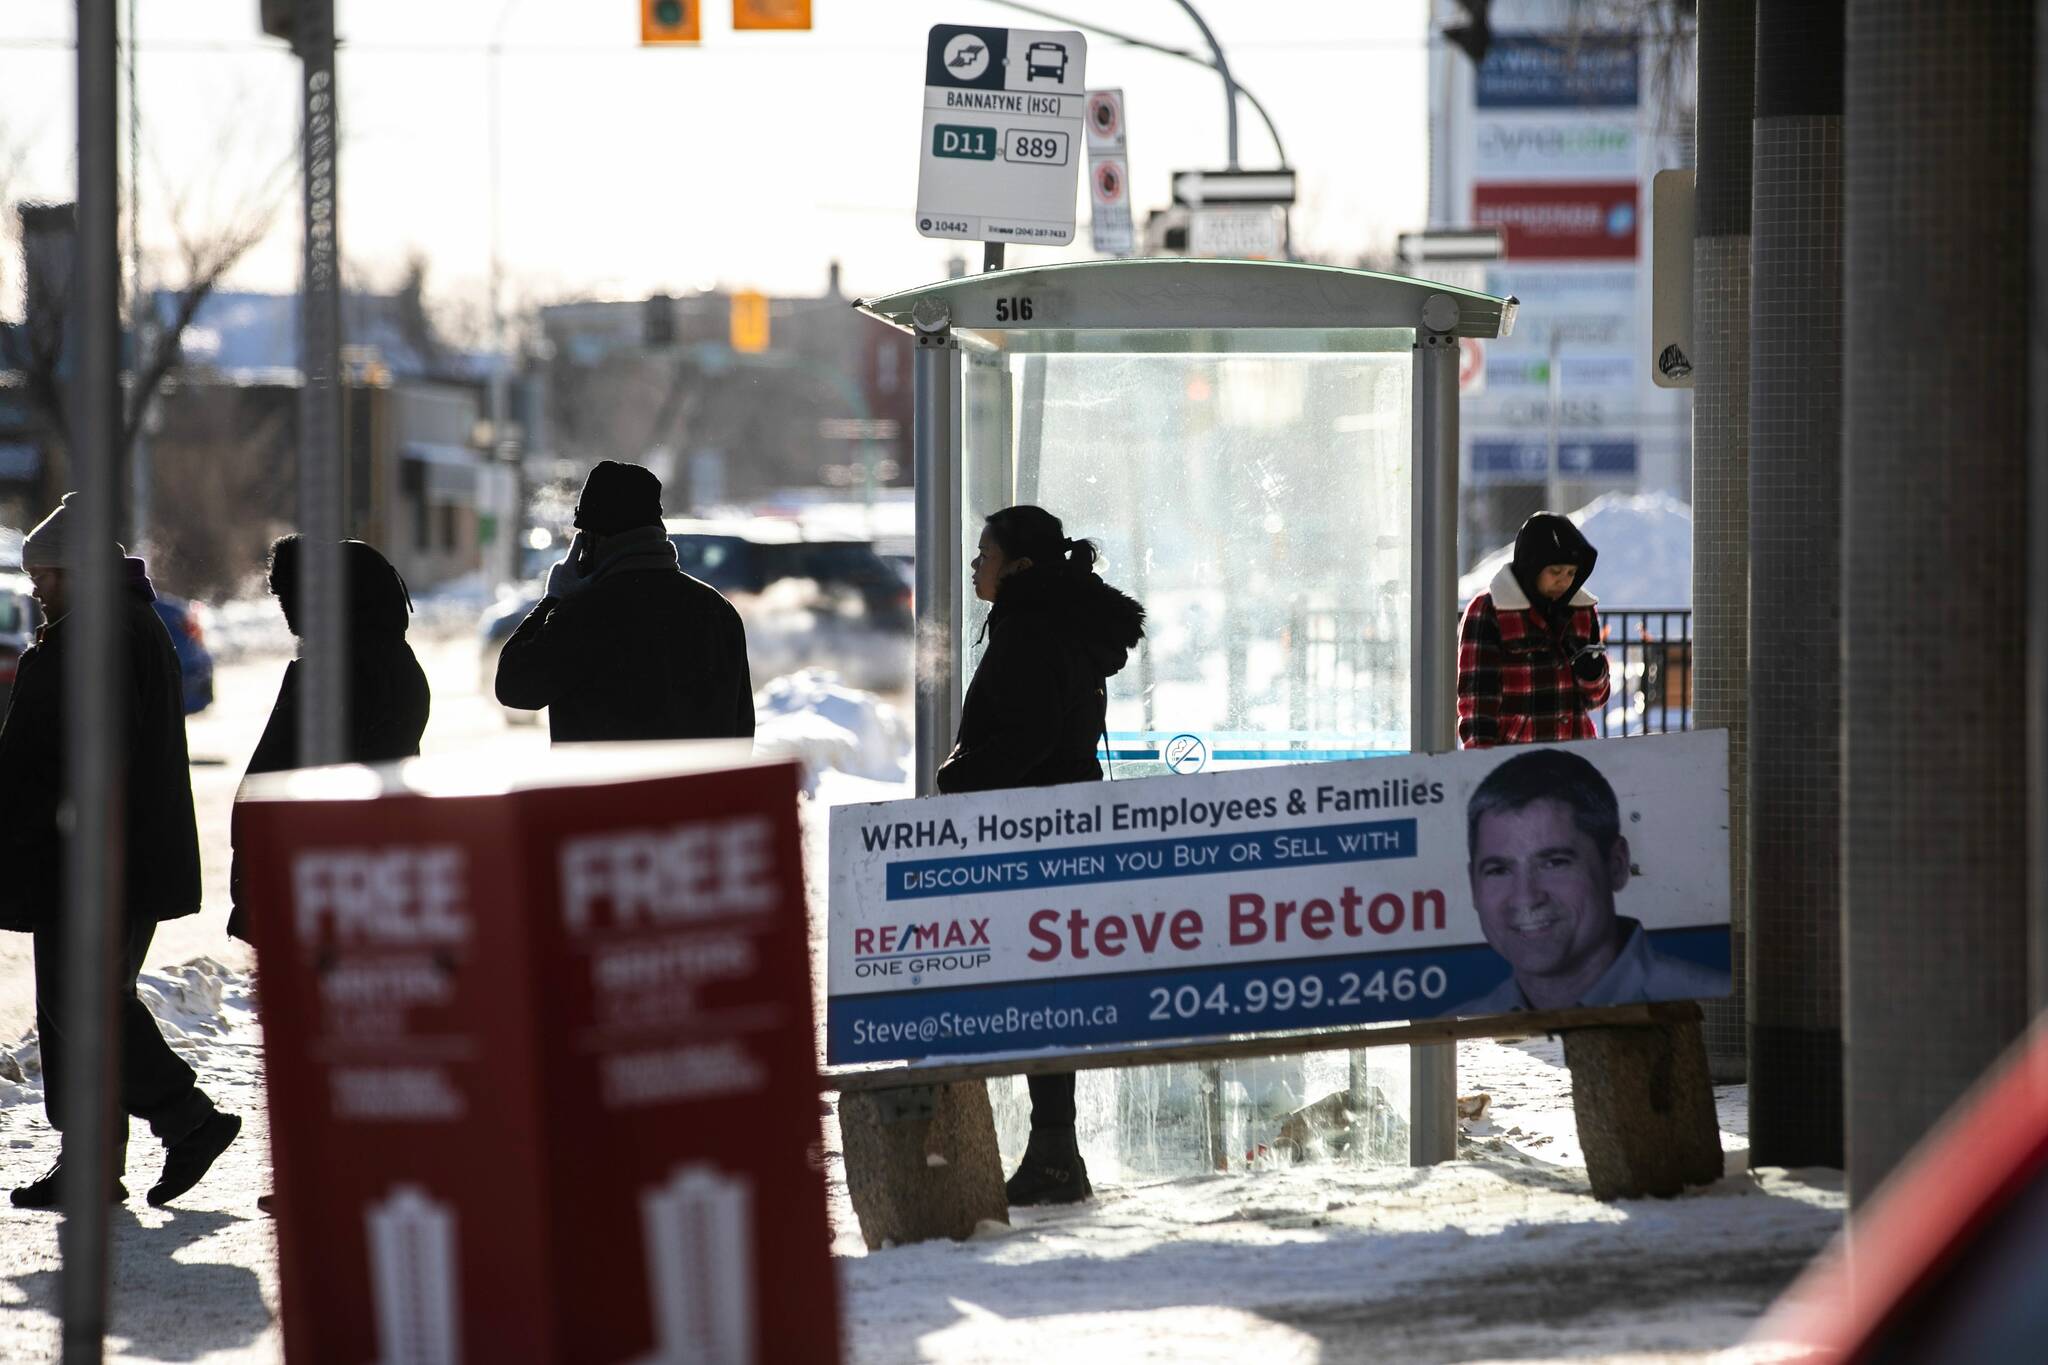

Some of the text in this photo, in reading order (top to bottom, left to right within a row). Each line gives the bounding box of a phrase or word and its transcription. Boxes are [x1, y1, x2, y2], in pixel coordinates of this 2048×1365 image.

[946, 91, 1061, 117] BANNATYNE (HSC)
[943, 130, 1057, 158] D11 889
[935, 220, 968, 233] 10442
[996, 296, 1033, 321] 516
[861, 779, 1444, 852] WRHA, Hospital Employees & Families
[562, 822, 777, 932] FREE
[903, 861, 1029, 890] DISCOUNTS
[1039, 855, 1105, 879] WHEN
[1115, 851, 1163, 873] YOU
[1229, 843, 1262, 862] OR
[1337, 831, 1399, 854] WITH
[295, 847, 470, 944] FREE
[854, 918, 991, 955] RE/MAX
[1027, 886, 1446, 963] Steve Breton
[855, 953, 991, 978] ONE GROUP
[1148, 965, 1447, 1021] 204.999.2460
[853, 1004, 1118, 1045] Steve@SteveBreton.ca
